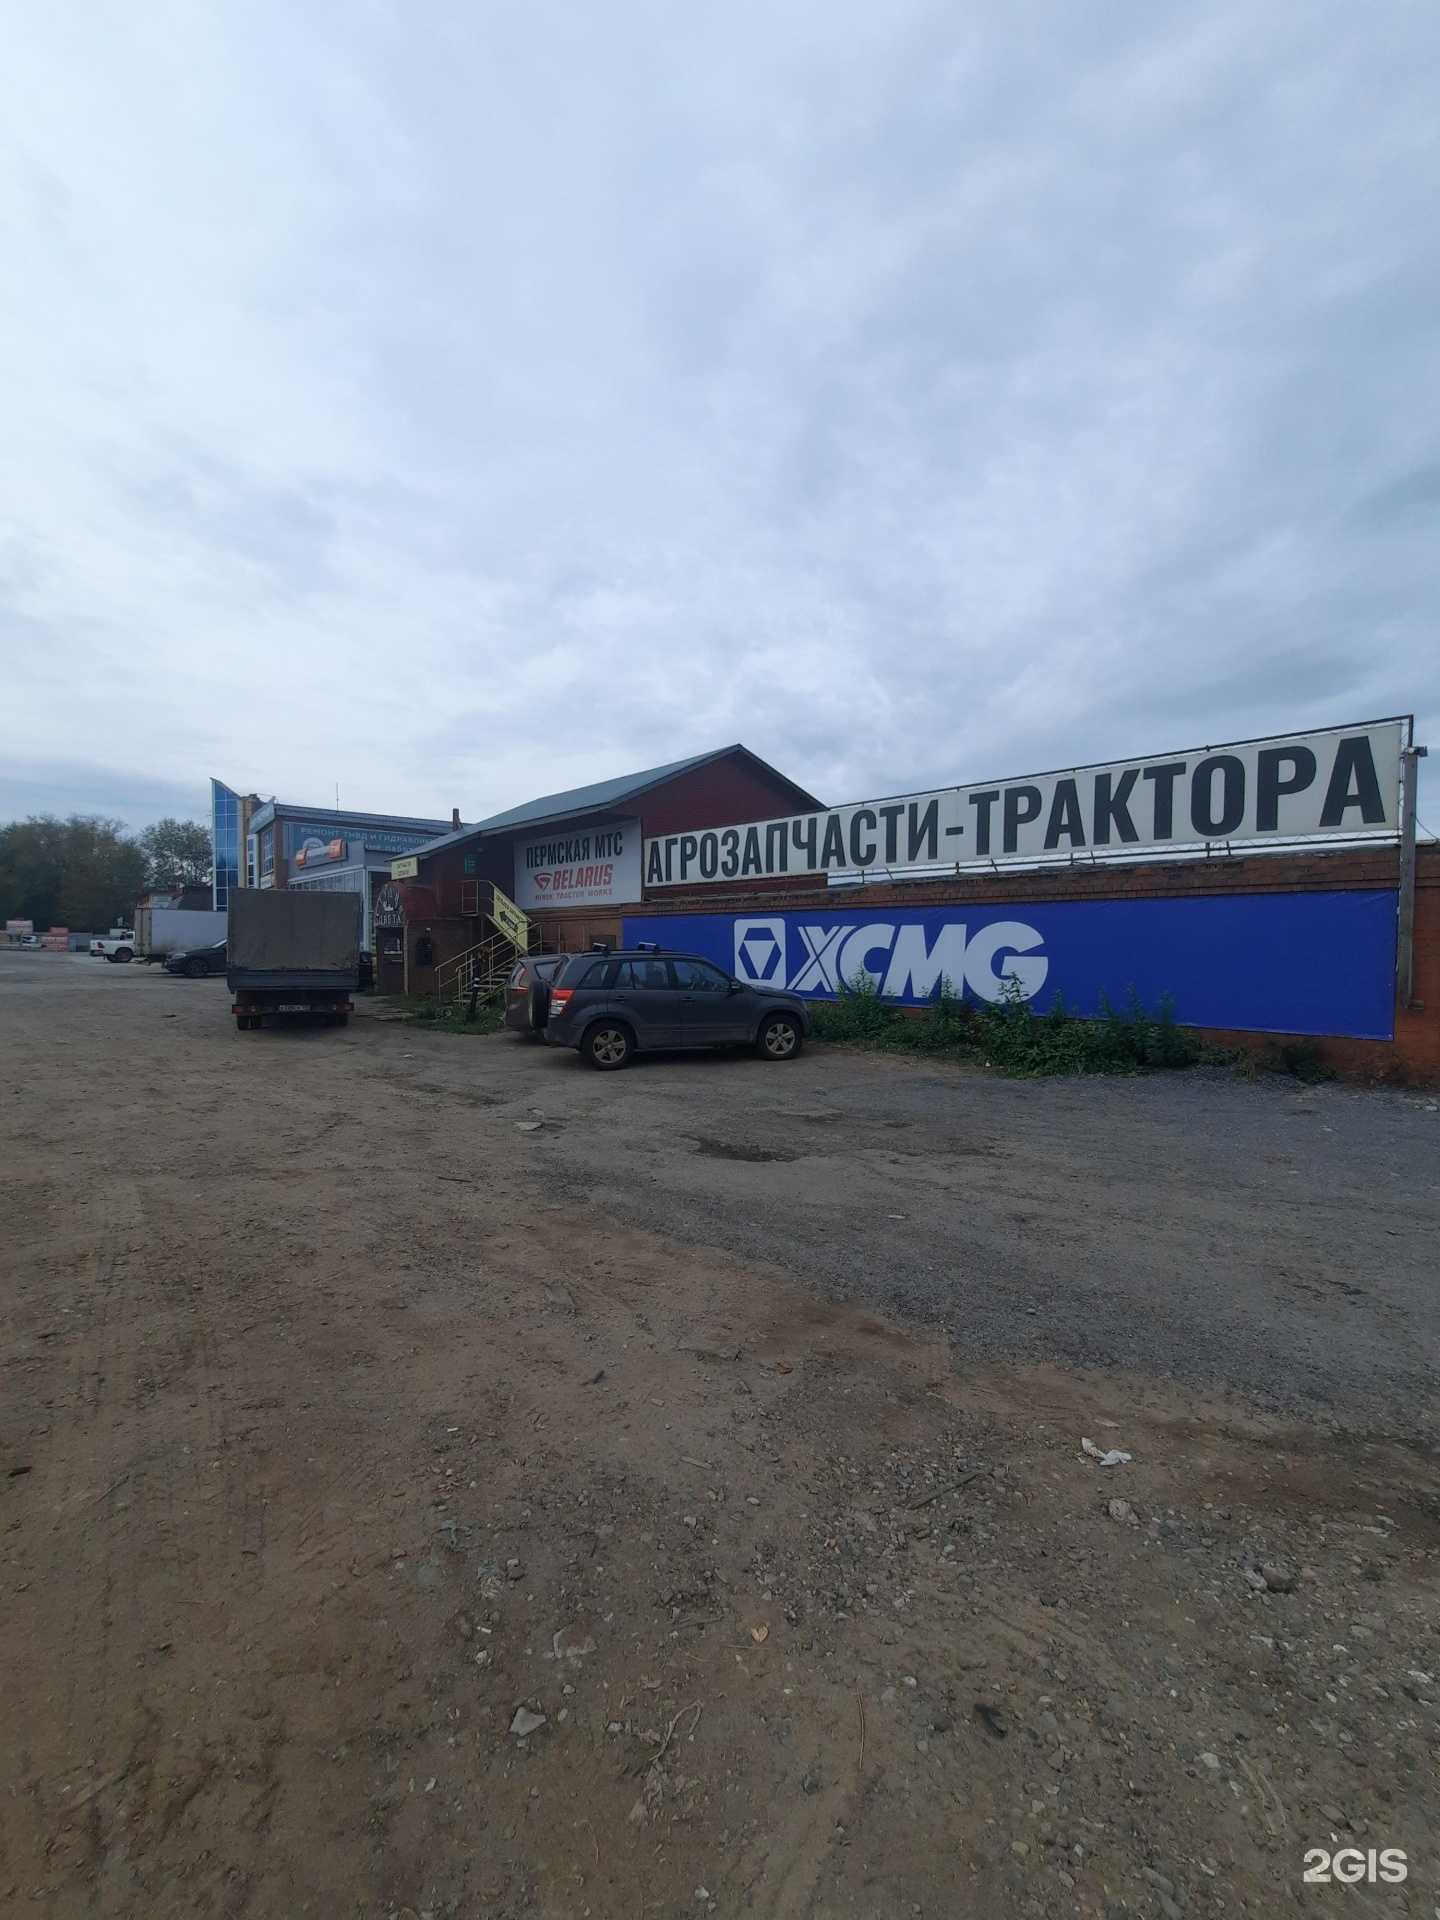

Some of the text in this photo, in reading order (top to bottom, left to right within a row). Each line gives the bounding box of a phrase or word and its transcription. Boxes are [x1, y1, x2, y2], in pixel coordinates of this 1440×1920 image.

[647, 736, 1387, 884] АГРОЗАПЧАСТИ-ТРАКТОРА
[526, 831, 623, 869] ПЕРМСКАЯ МТС
[552, 864, 614, 891] BELARUS
[786, 920, 1049, 1005] XCMG
